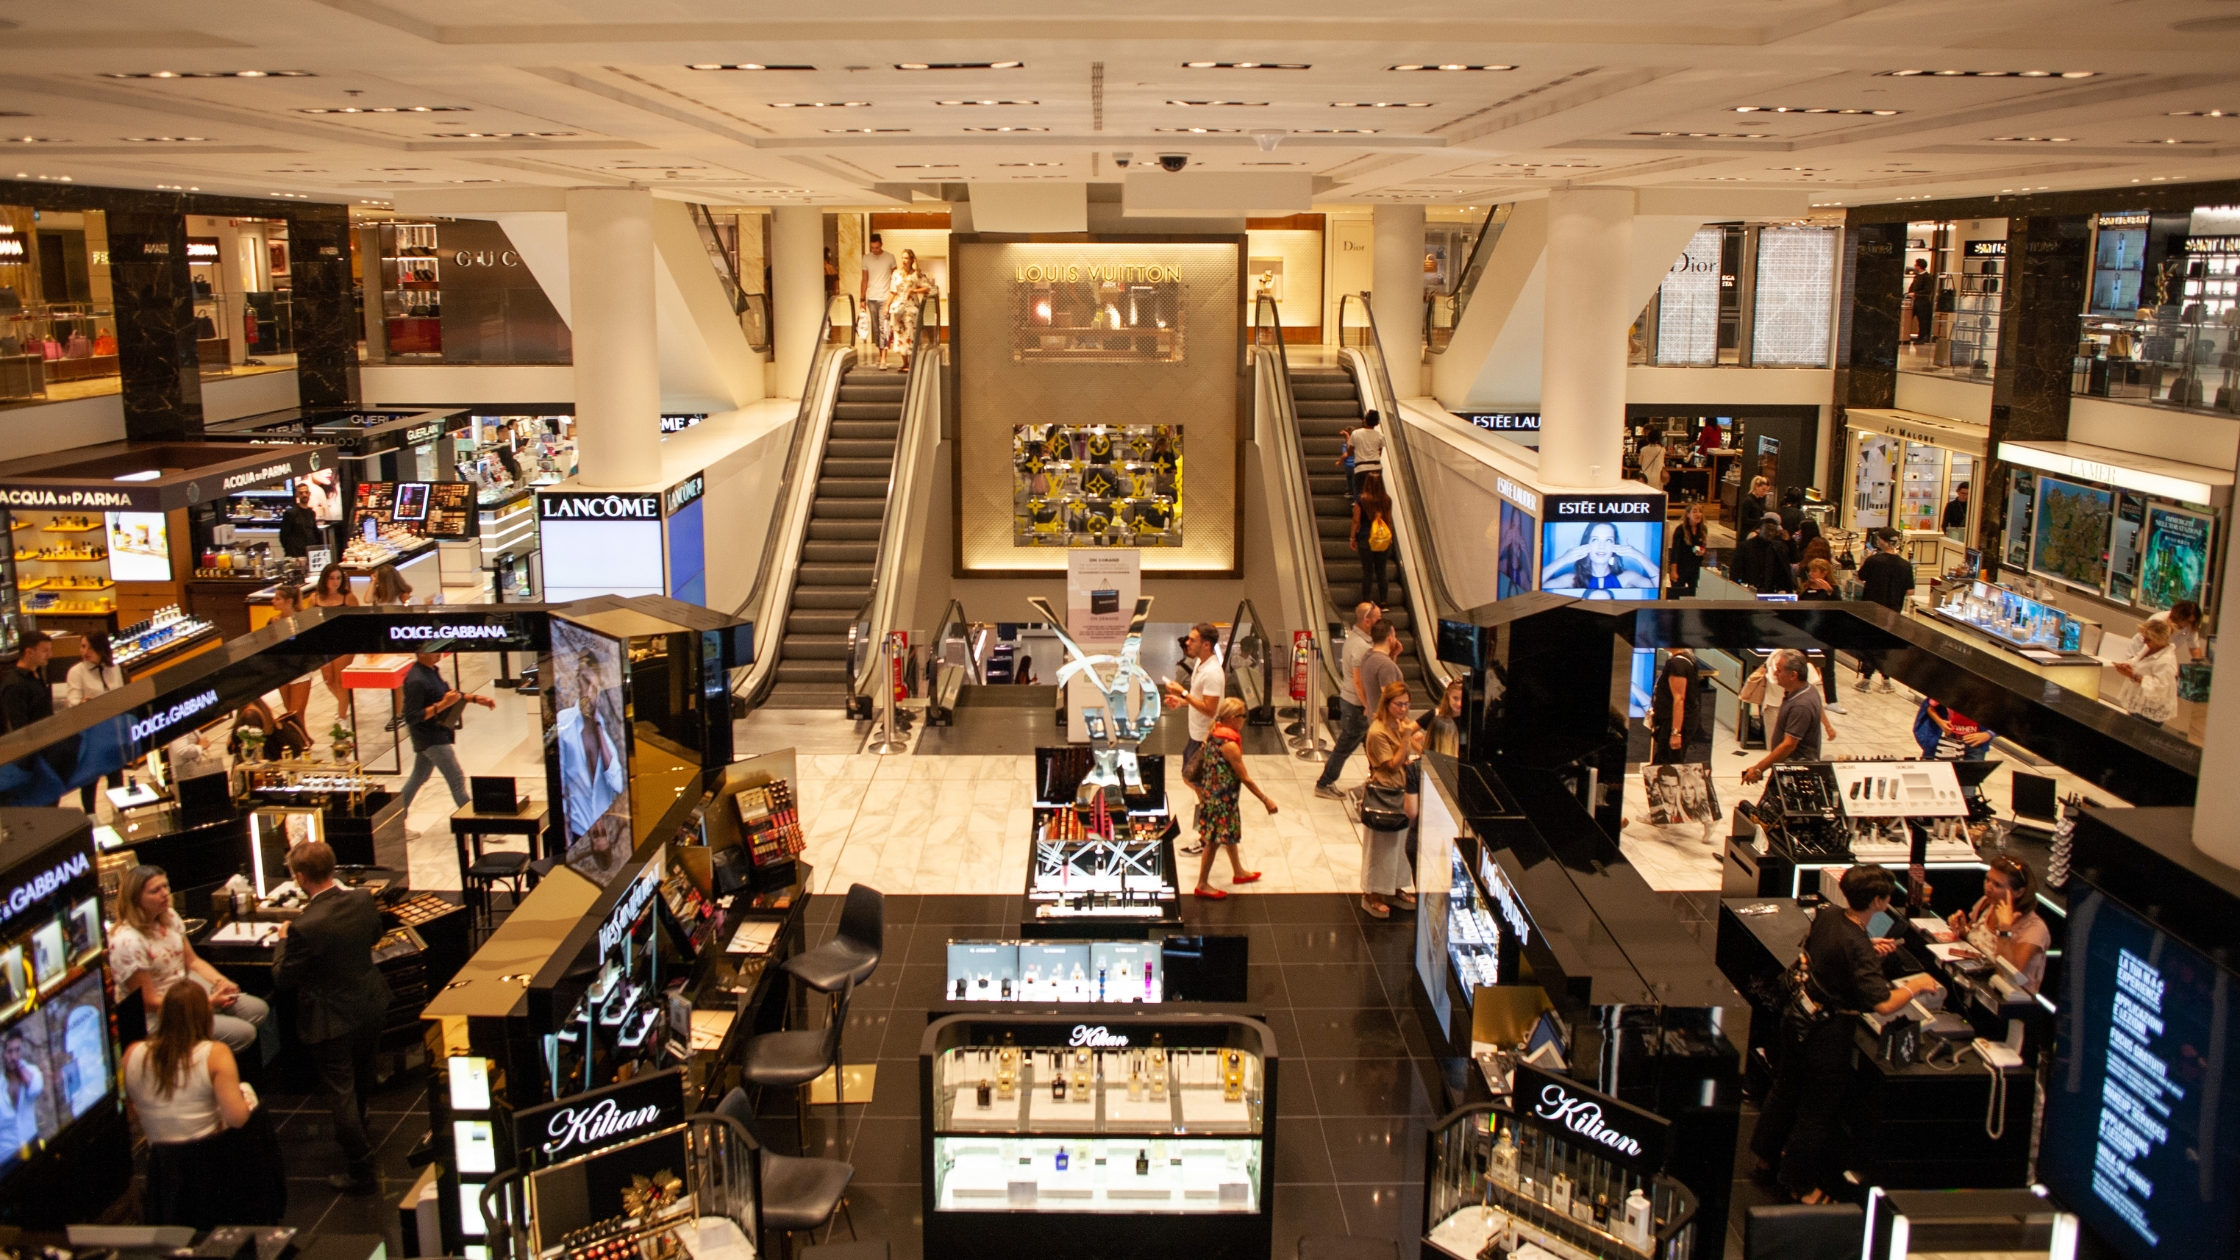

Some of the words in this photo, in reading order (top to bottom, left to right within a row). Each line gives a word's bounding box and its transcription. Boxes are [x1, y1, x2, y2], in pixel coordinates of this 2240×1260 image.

[1343, 241, 1365, 251] Dior
[1016, 265, 1079, 283] LOUIS
[1087, 264, 1182, 283] VUITTON
[1899, 428, 1936, 444] MALONE
[223, 471, 255, 490] ACQUA
[262, 463, 292, 479] PARMA
[2069, 458, 2087, 477] LA
[2089, 464, 2116, 484] MER
[0, 489, 57, 505] ACQUA
[72, 491, 132, 506] PARMA
[667, 477, 698, 511] LANCÔME
[543, 495, 657, 517] LANCÔME
[1598, 502, 1650, 514] LAUDER
[1068, 1024, 1129, 1047] Kilian
[543, 1099, 660, 1153] Kilian
[1535, 1084, 1642, 1156] Kilian
